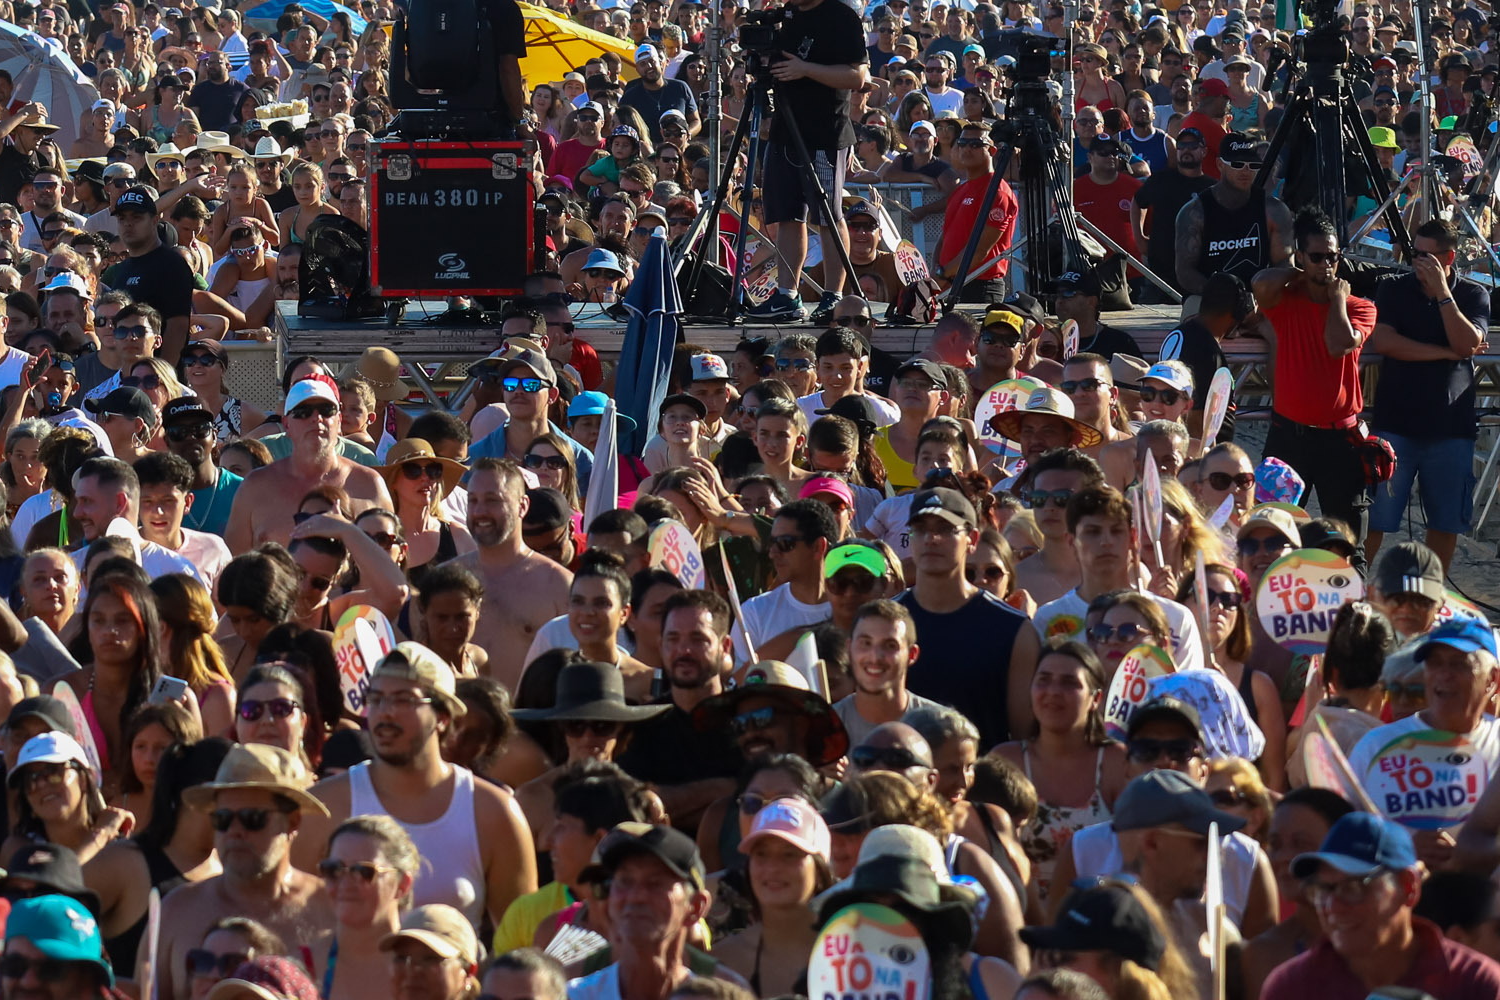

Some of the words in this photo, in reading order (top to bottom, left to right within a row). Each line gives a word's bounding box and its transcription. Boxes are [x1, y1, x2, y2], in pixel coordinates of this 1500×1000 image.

[385, 192, 429, 206] BEAM
[434, 189, 479, 207] 380
[1209, 236, 1259, 252] ROCKET
[989, 391, 1008, 404] EU
[1268, 573, 1293, 592] EU
[1317, 592, 1340, 605] NA
[1124, 656, 1140, 674] EU
[1380, 754, 1406, 772] EU
[1435, 768, 1461, 782] NA
[1385, 773, 1477, 813] BAND!
[824, 934, 849, 957] EU
[875, 966, 901, 986] NA
